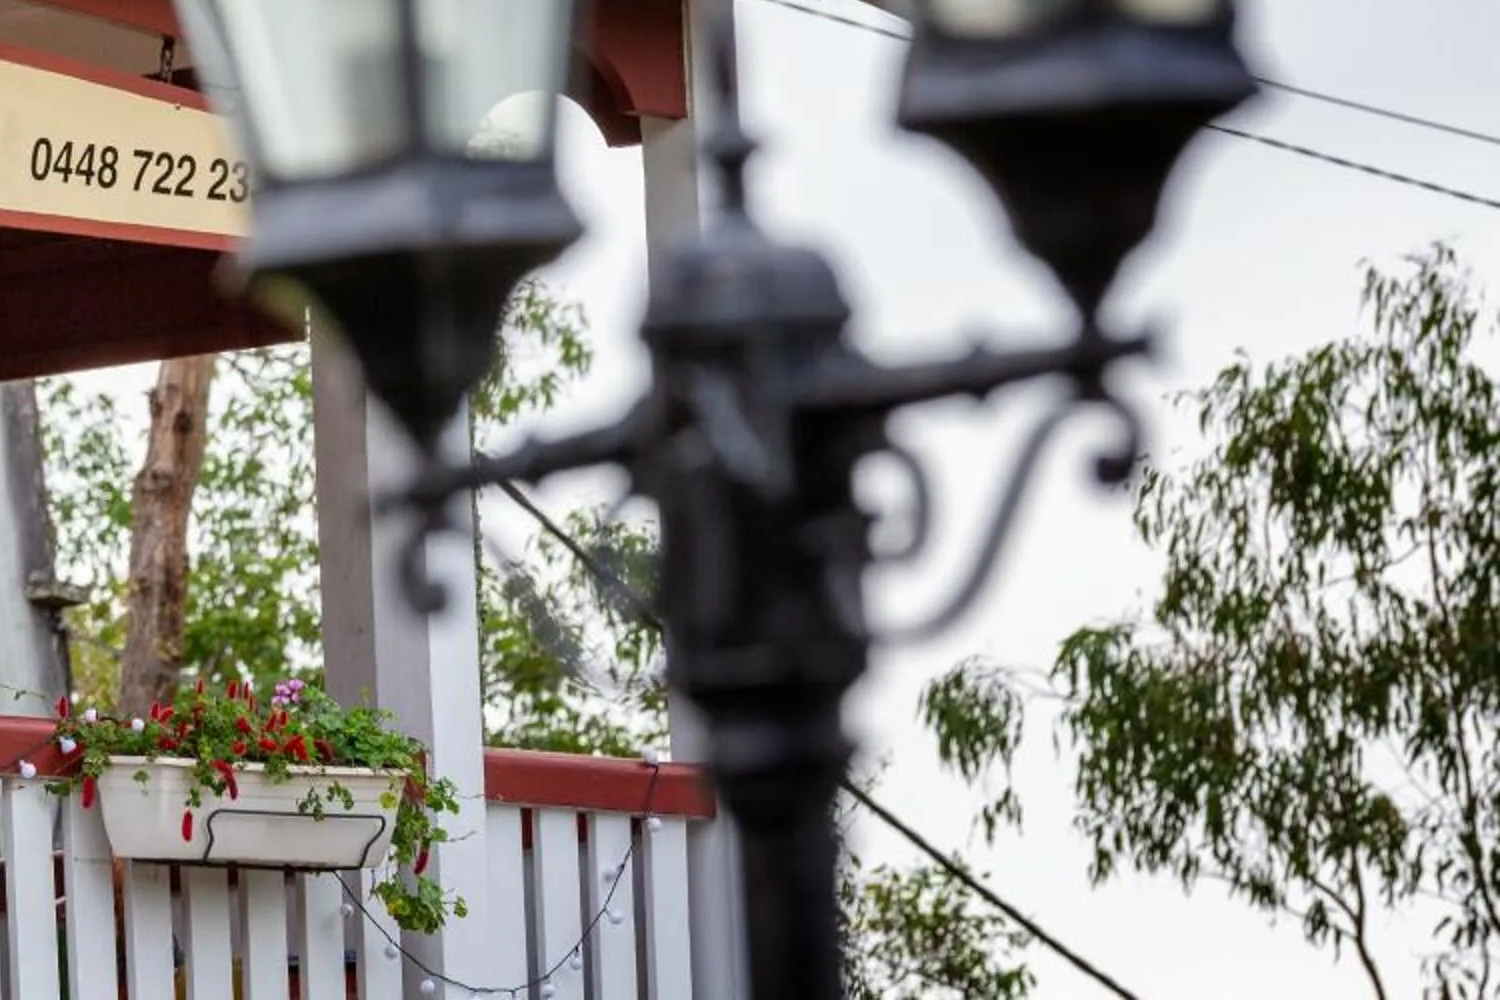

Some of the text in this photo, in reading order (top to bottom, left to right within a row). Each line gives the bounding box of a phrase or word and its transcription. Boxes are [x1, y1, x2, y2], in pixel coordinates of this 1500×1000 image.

[30, 137, 249, 203] 0448 722 23
